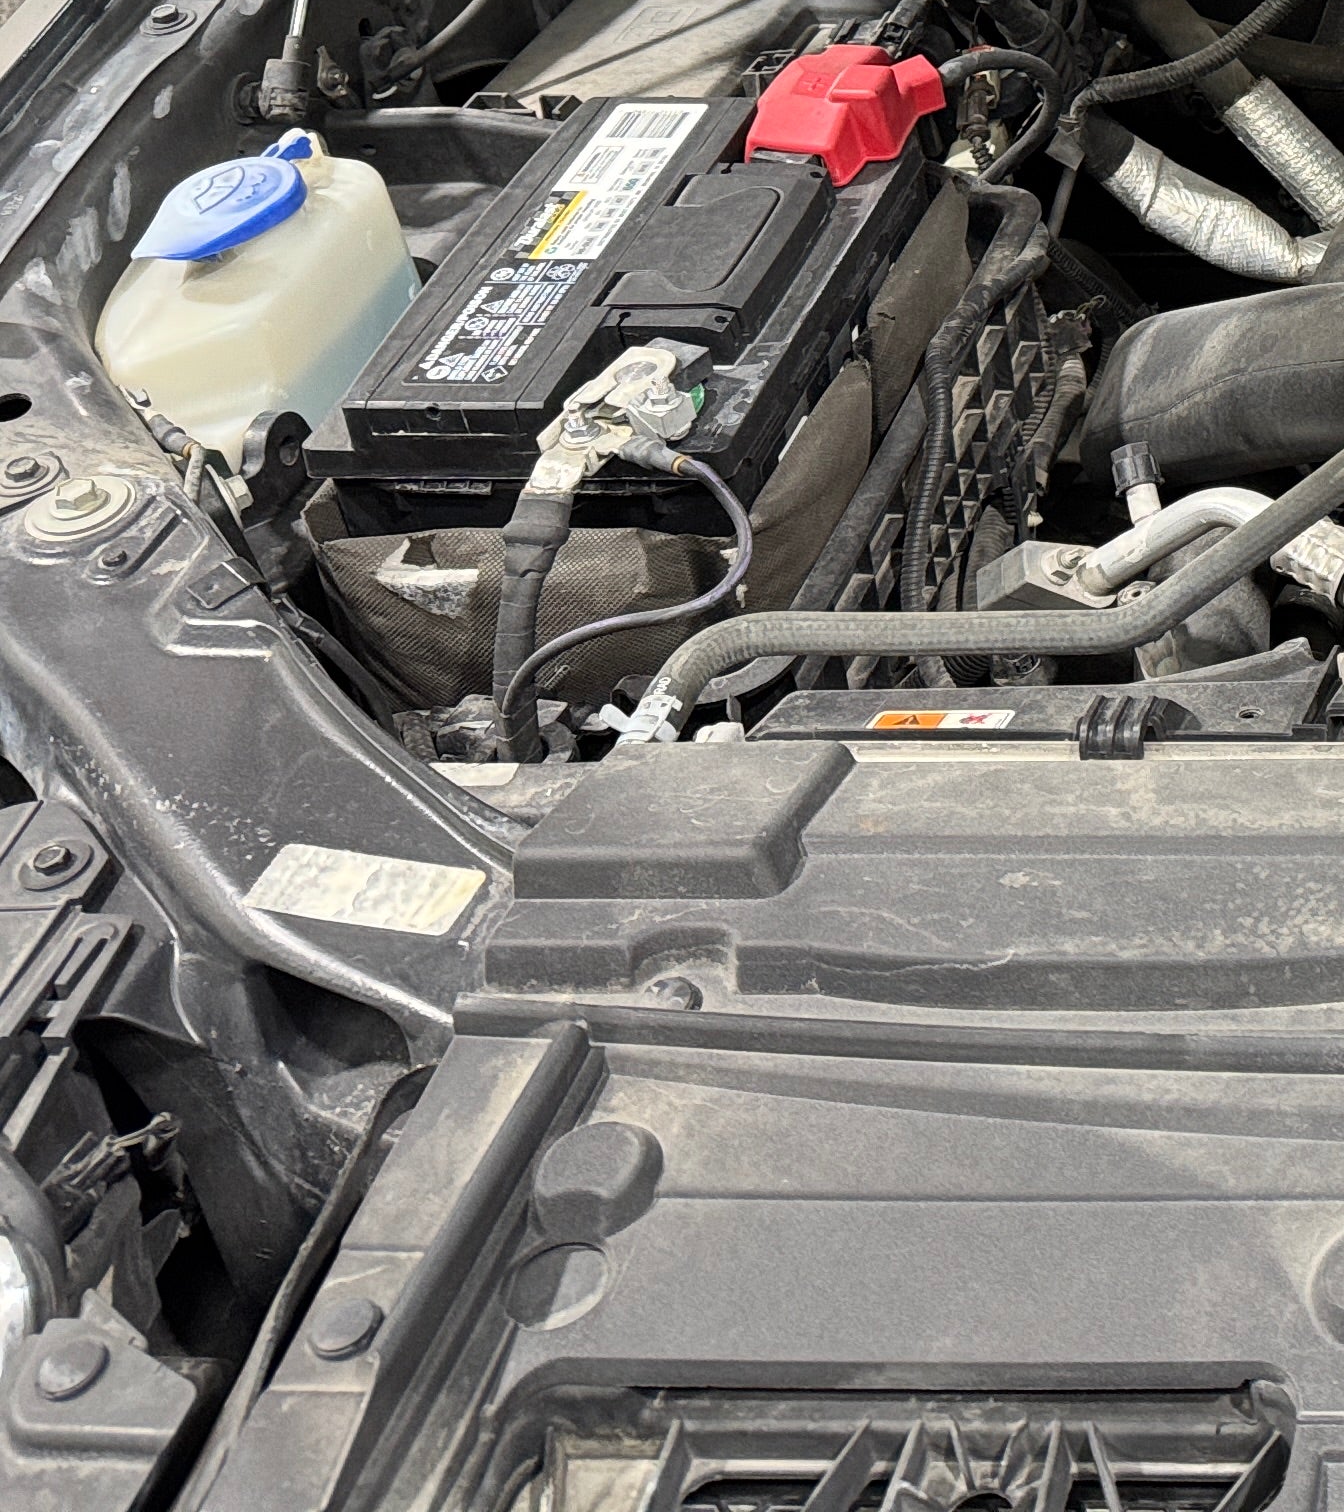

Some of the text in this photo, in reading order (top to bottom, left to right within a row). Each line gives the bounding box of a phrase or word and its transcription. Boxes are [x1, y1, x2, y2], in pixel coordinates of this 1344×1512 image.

[513, 202, 556, 247] Duralast
[425, 286, 494, 362] DANGER/POISON
[653, 676, 672, 696] RAD
